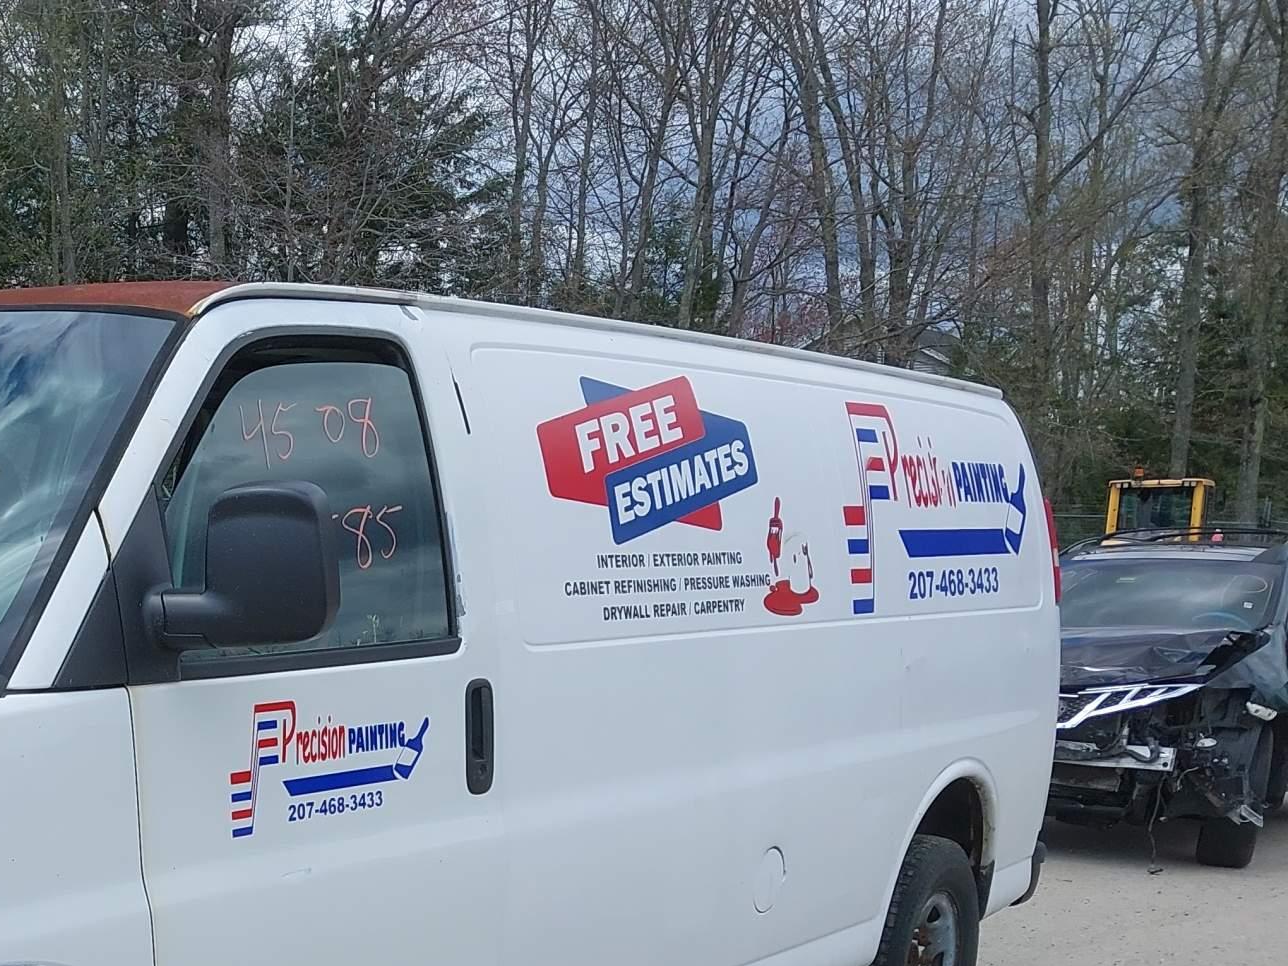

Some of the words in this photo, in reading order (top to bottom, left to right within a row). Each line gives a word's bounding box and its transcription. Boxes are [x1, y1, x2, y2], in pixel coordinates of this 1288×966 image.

[574, 395, 684, 474] FREE
[614, 439, 749, 525] ESTIMATES
[951, 461, 1011, 503] PAINTING
[597, 554, 645, 569] INTERIOR
[653, 553, 700, 567] EXTERIOR
[701, 552, 743, 566] PAINTING
[564, 581, 611, 596] CABINET
[614, 578, 677, 594] REFINISHING
[684, 576, 730, 591] PRESSURE
[732, 574, 771, 588] WASHING
[908, 567, 999, 600] 207-468-3433
[603, 606, 651, 621] DRYWALL
[653, 603, 687, 618] REPAIR
[694, 599, 745, 615] CARPENTRY
[260, 701, 345, 764] Precision
[348, 721, 406, 754] PAINTING
[288, 790, 384, 822] 207-468-3433
